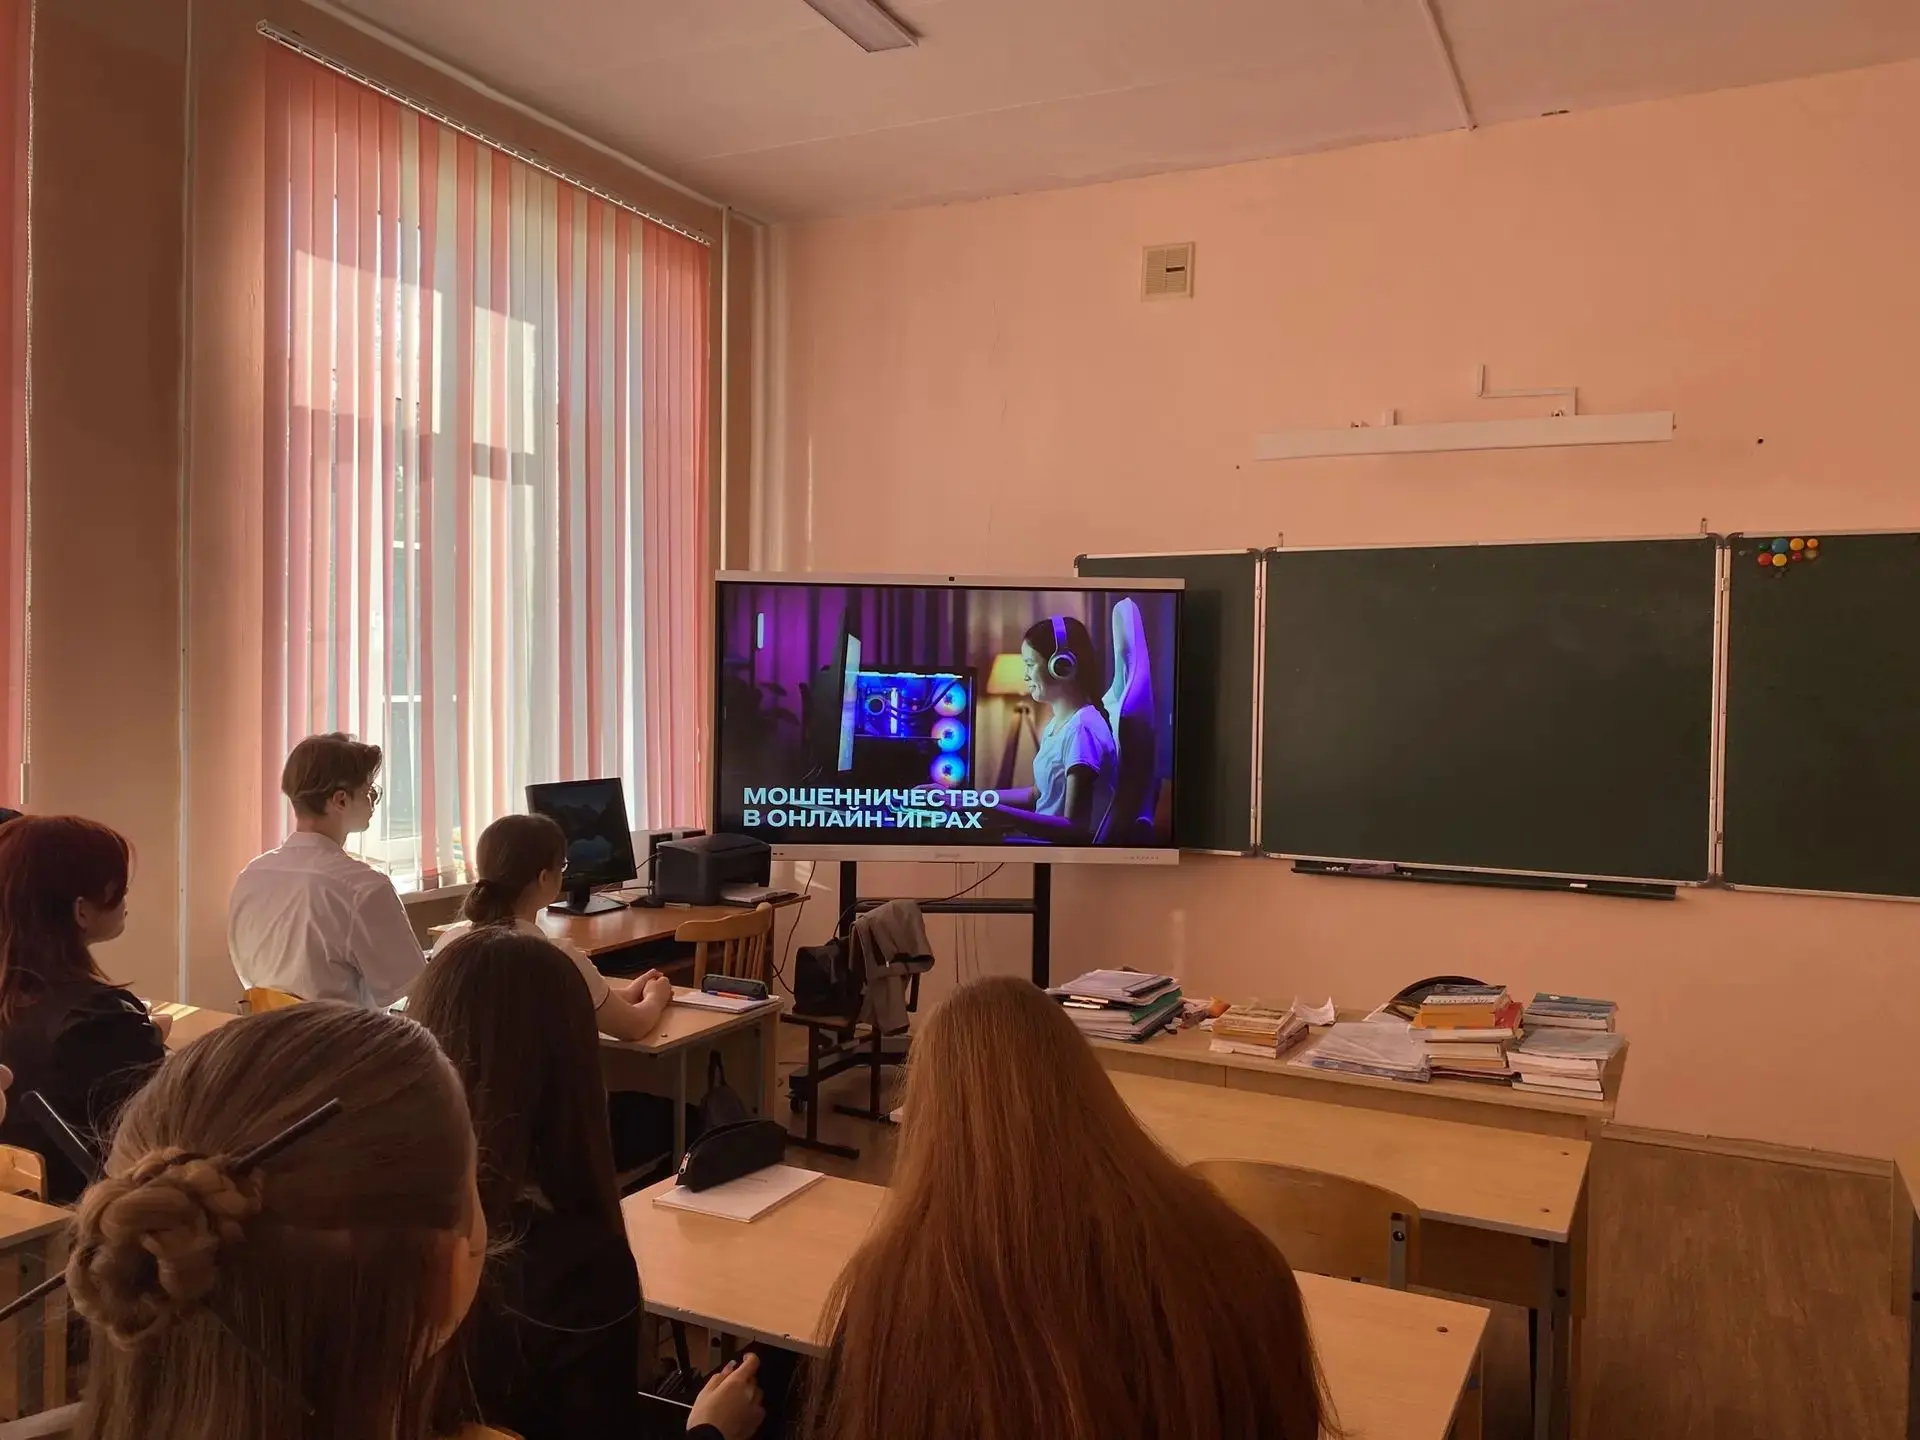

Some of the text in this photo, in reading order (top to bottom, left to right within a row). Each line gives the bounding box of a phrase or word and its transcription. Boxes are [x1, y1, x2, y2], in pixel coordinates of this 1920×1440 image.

[743, 787, 1000, 808] МОШЕННИЧЕСТВО
[743, 806, 983, 829] В ОНЛАЙН-ИГРАХ
